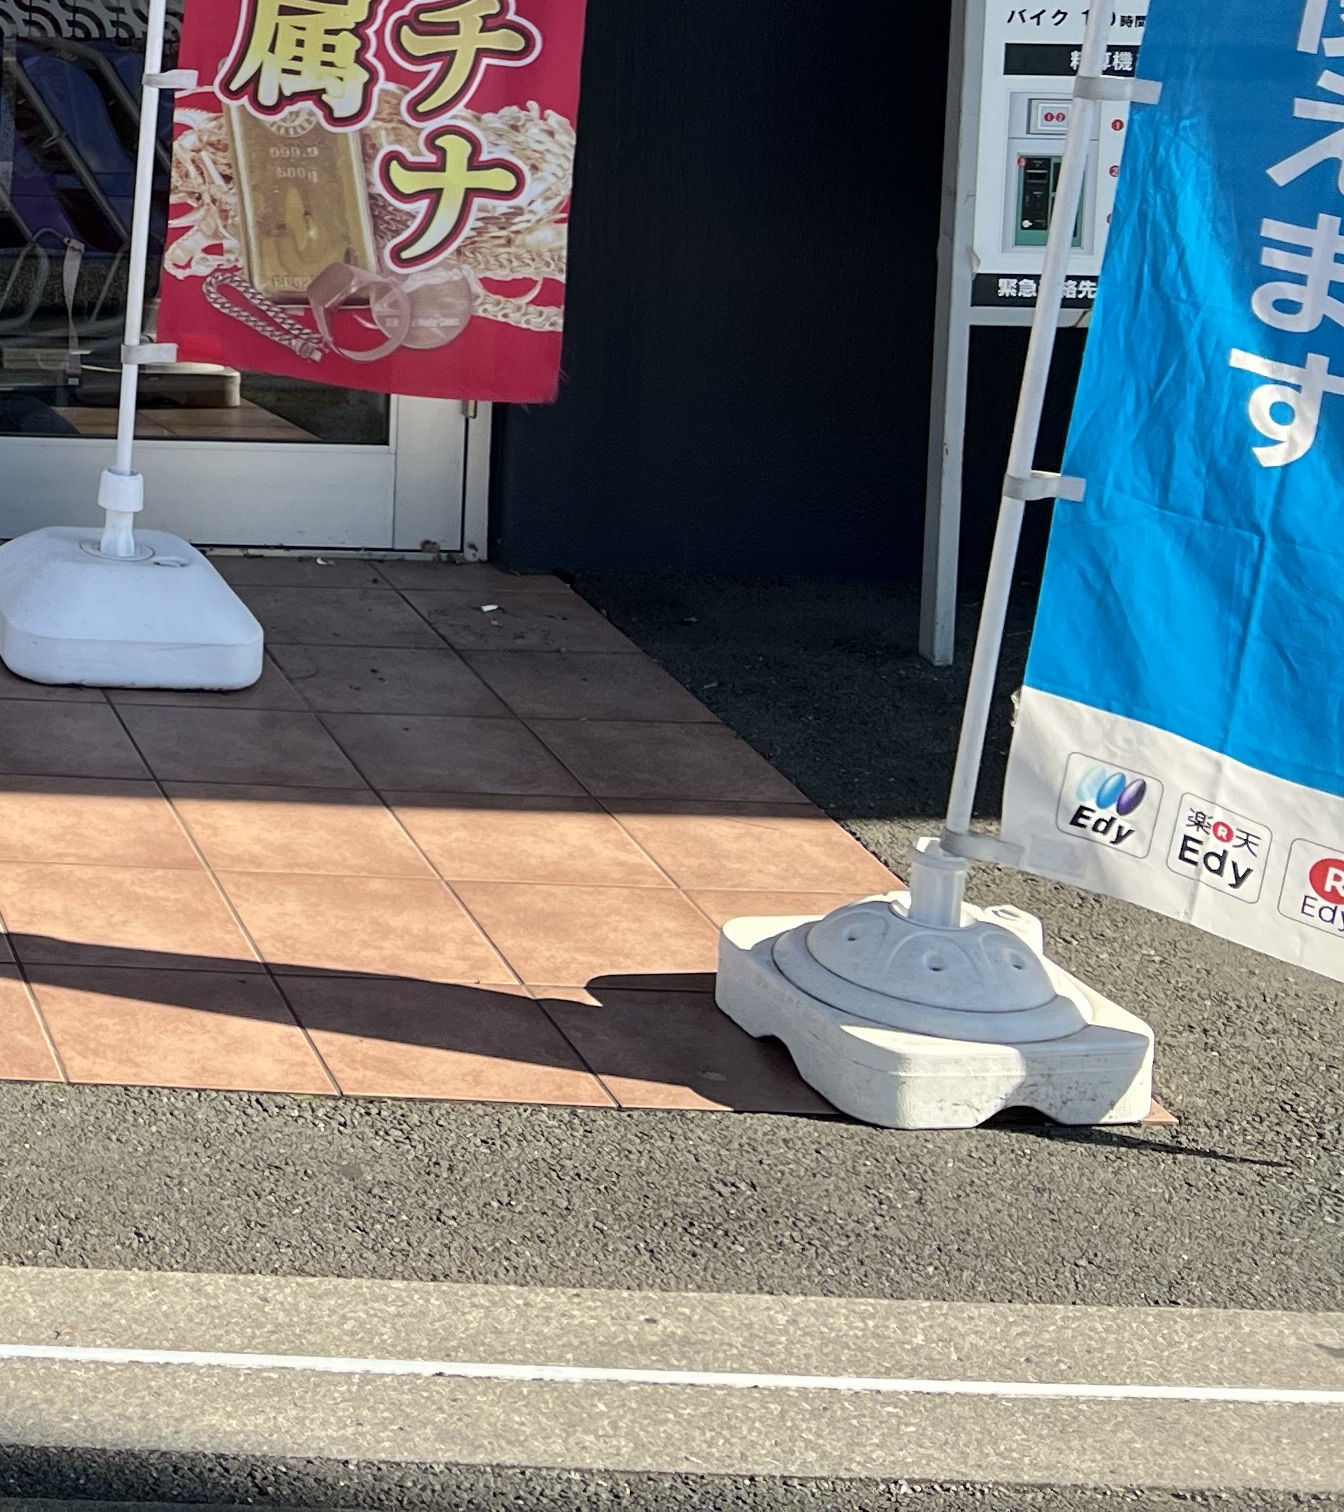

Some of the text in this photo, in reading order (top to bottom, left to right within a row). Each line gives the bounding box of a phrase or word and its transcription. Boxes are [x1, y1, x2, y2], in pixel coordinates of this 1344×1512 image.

[1007, 8, 1069, 27] バイク
[997, 277, 1098, 299] 緊急絡先
[1068, 804, 1135, 846] Edy
[1177, 833, 1254, 890] Edy
